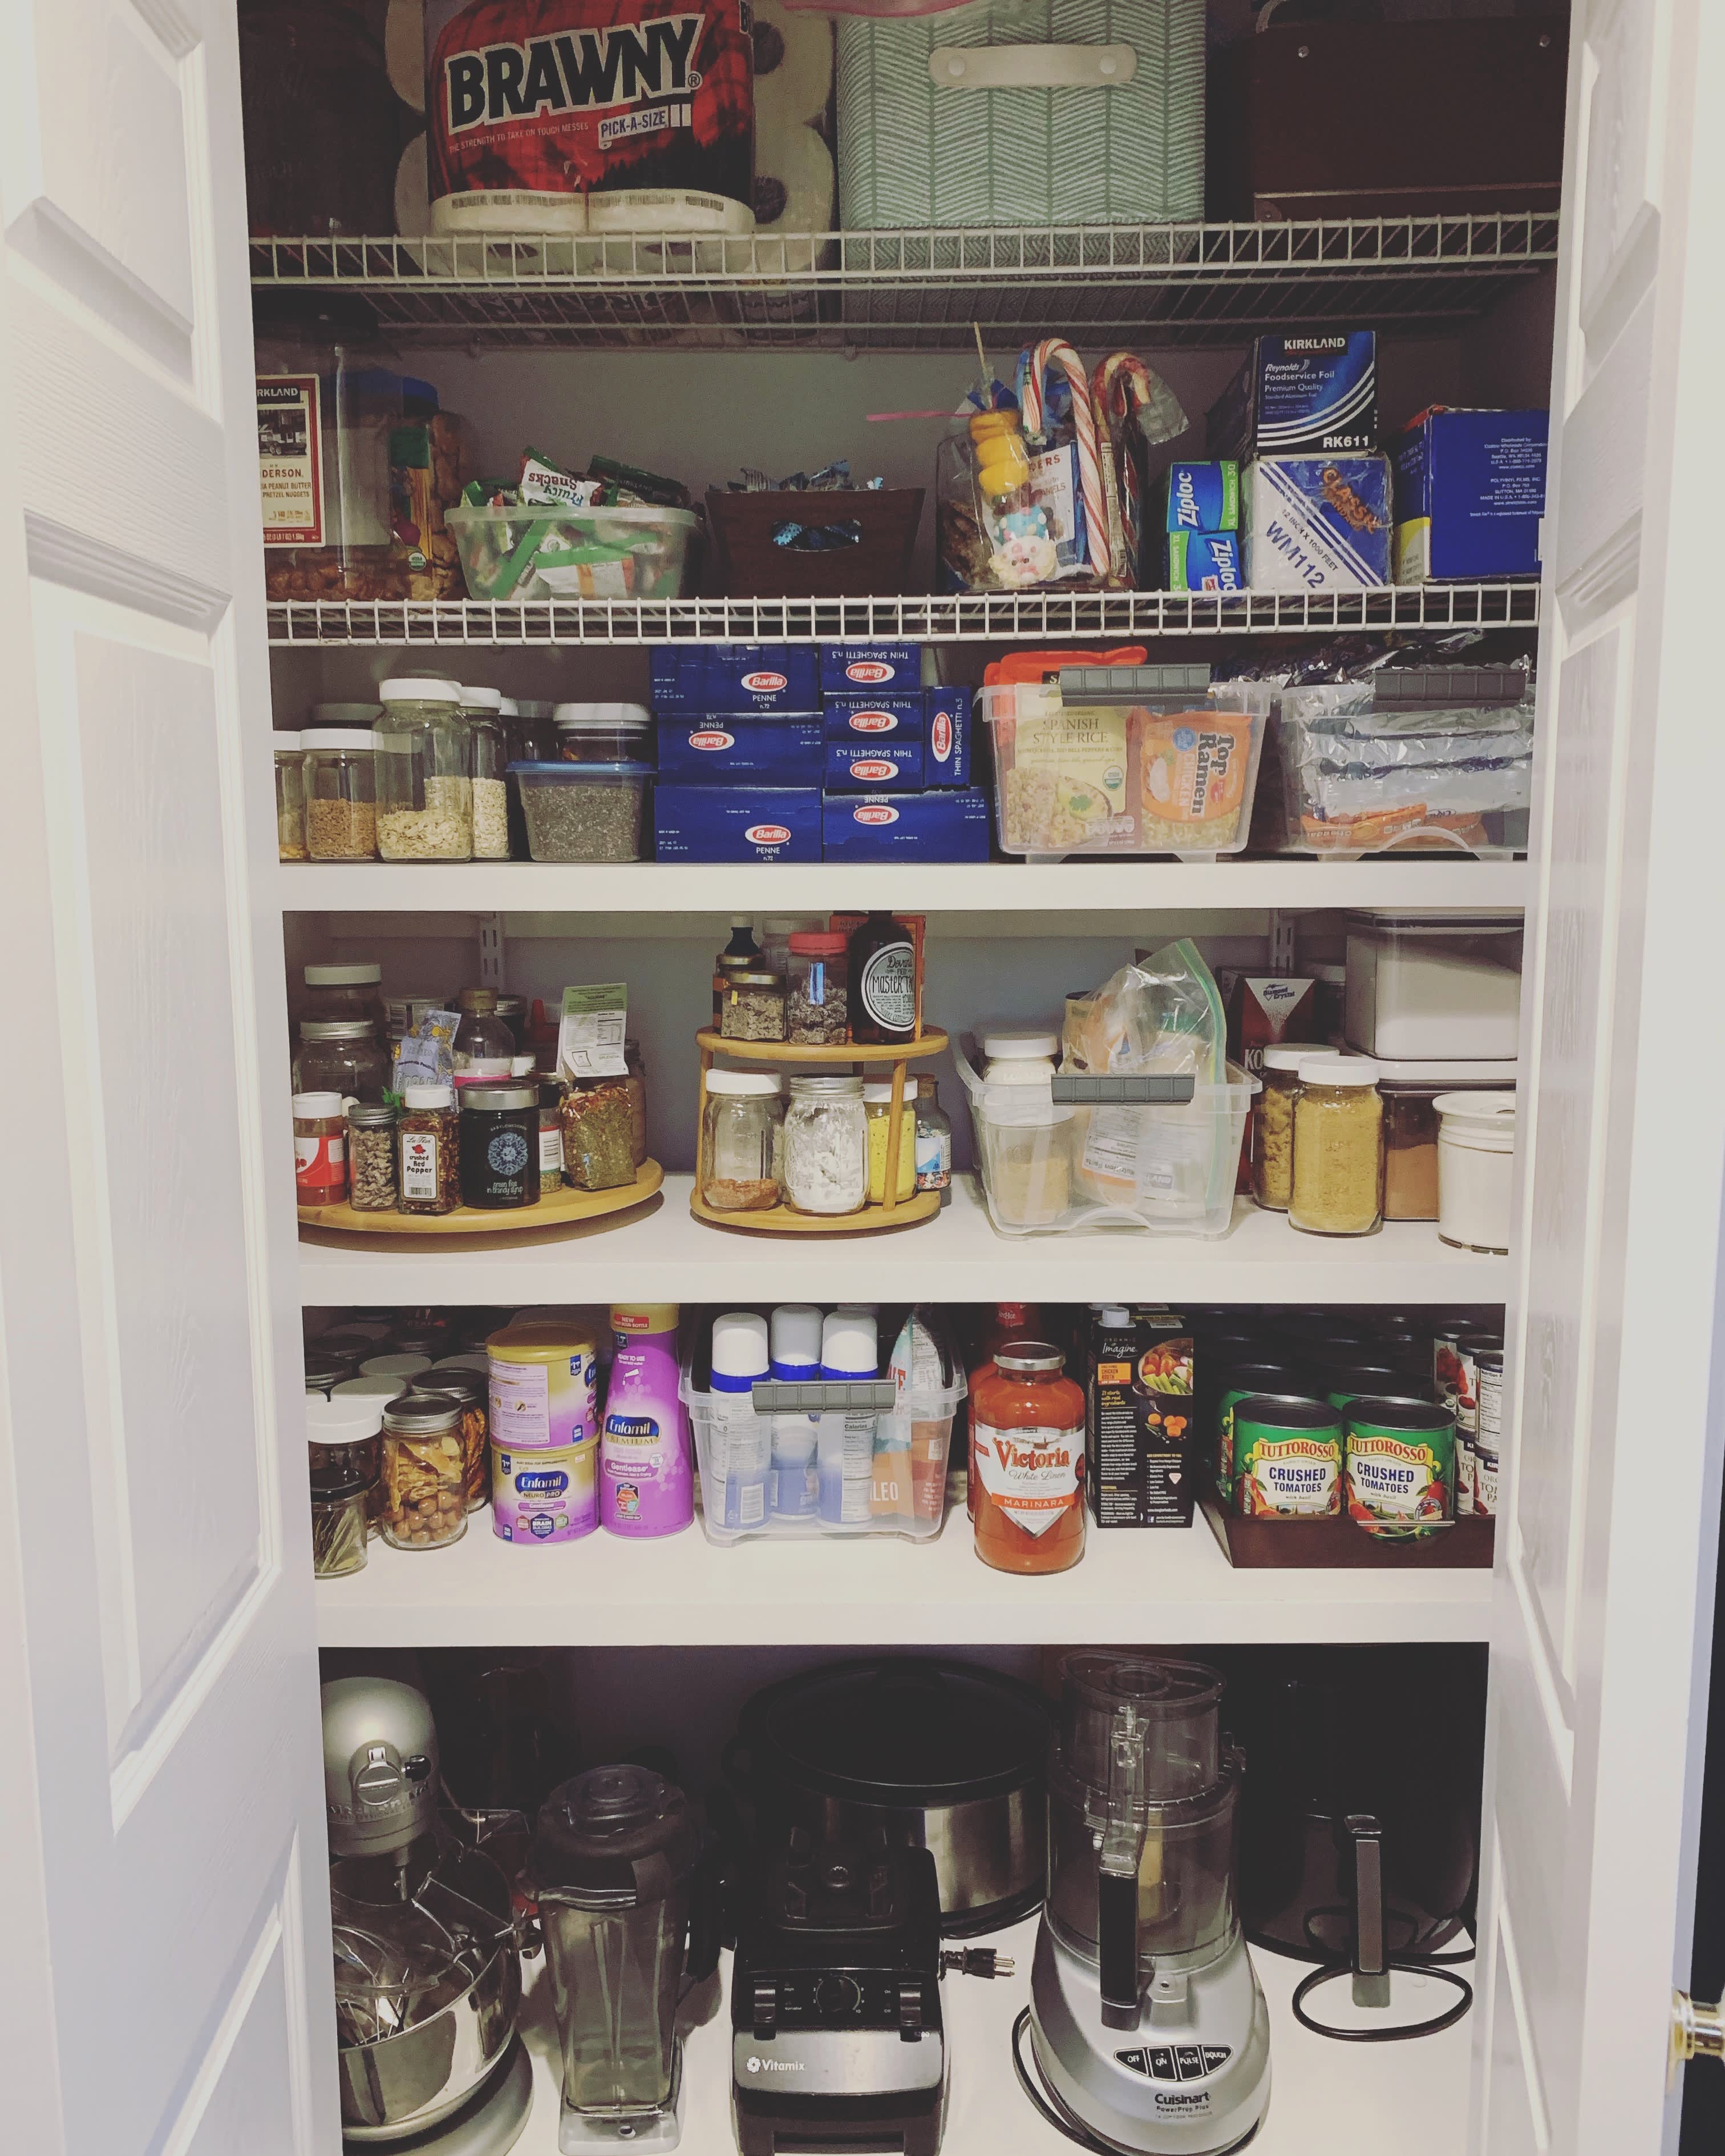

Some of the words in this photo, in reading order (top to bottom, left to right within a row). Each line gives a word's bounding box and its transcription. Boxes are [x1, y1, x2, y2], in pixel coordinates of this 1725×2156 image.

[447, 17, 701, 129] BRAWNY
[601, 111, 666, 138] PICK-A-SIZE
[460, 136, 495, 149] STRENGTH
[507, 131, 523, 140] TAKE
[538, 125, 560, 136] TOUGH
[561, 122, 589, 132] MESSES
[1284, 337, 1346, 350] KIRKLAND
[1265, 363, 1300, 374] Reynolds
[1265, 372, 1317, 382] Foodservice
[257, 387, 299, 398] RKLAND
[1323, 435, 1368, 448] RK611
[262, 468, 301, 478] DERSON
[1227, 464, 1236, 477] 30
[528, 472, 577, 490] Snacks
[543, 485, 584, 506] Fruity
[1177, 472, 1200, 528] Ziploc
[1282, 509, 1290, 518] 12
[1309, 538, 1323, 556] 1000
[1322, 553, 1339, 571] FEET
[1266, 520, 1325, 589] WM112
[1212, 540, 1237, 591] Ziploc
[850, 668, 884, 678] Barilla
[752, 676, 783, 686] Barilla
[853, 718, 887, 727] Barilla
[1043, 718, 1099, 730] SPANISH
[937, 716, 946, 751] Barilla
[1033, 733, 1073, 744] STYLE
[1077, 732, 1108, 743] RICE
[693, 736, 724, 746] Barilla
[854, 766, 888, 776] Barilla
[1192, 733, 1217, 814] Ramen
[857, 812, 889, 821] Barilla
[755, 829, 787, 839] Barilla
[1263, 987, 1289, 996] Diamond
[1274, 991, 1295, 1000] Crystal
[407, 1166, 432, 1174] Pepper
[492, 1186, 510, 1195] brandy
[511, 1186, 523, 1194] syrup
[1102, 1343, 1137, 1358] Imagine
[610, 1419, 650, 1435] Enfamil
[606, 1435, 654, 1445] PREMIUM
[991, 1437, 1071, 1472] Victoria
[1260, 1441, 1334, 1458] TUTTOROSSO
[1351, 1437, 1427, 1461] TUTTOROSSO
[611, 1462, 649, 1473] Gentlease
[1357, 1461, 1415, 1483] CRUSHED
[1009, 1469, 1038, 1481] White
[1040, 1470, 1066, 1481] Linen
[1269, 1467, 1326, 1482] CRUSHED
[521, 1476, 562, 1489] Enfamil
[1274, 1482, 1322, 1493] TOMATOES
[1360, 1477, 1409, 1494] TOMATOES
[870, 1481, 899, 1502] LEO
[1004, 1498, 1064, 1507] MARINARA
[762, 2058, 805, 2072] Vitamix
[1155, 2057, 1167, 2066] ON
[1180, 2056, 1199, 2065] PULSE
[1155, 2092, 1209, 2105] Cuisinart
